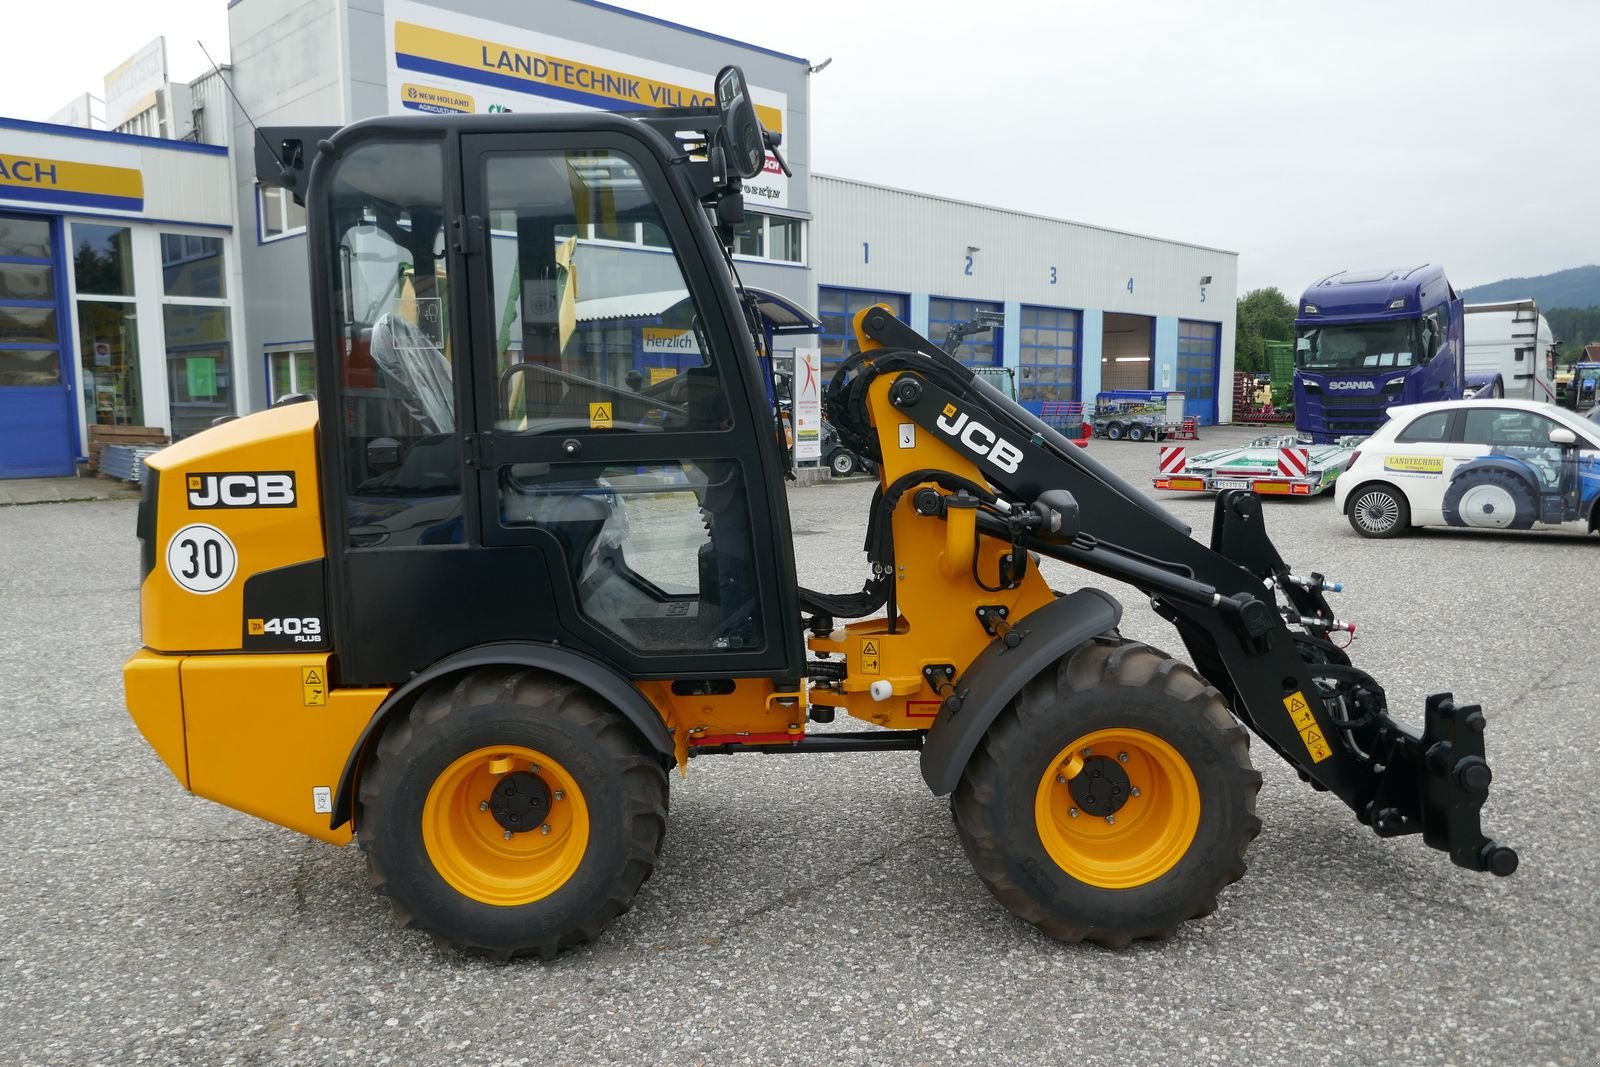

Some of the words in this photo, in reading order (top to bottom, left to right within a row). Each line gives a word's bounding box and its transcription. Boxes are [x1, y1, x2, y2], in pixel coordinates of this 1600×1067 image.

[482, 46, 640, 99] LANDTECHNIK
[419, 92, 436, 102] NEW
[436, 95, 470, 108] HOLLAND
[863, 242, 869, 264] 1
[965, 256, 973, 276] 2
[1050, 266, 1057, 285] 3
[1127, 277, 1134, 294] 4
[1200, 287, 1206, 303] 5
[646, 333, 692, 349] Herzlich
[1329, 381, 1375, 390] SCANIA
[936, 412, 1024, 474] JCB
[1390, 457, 1442, 466] LANDTECHNIK
[189, 475, 295, 506] JCB
[180, 538, 223, 579] 30
[264, 617, 321, 635] 403
